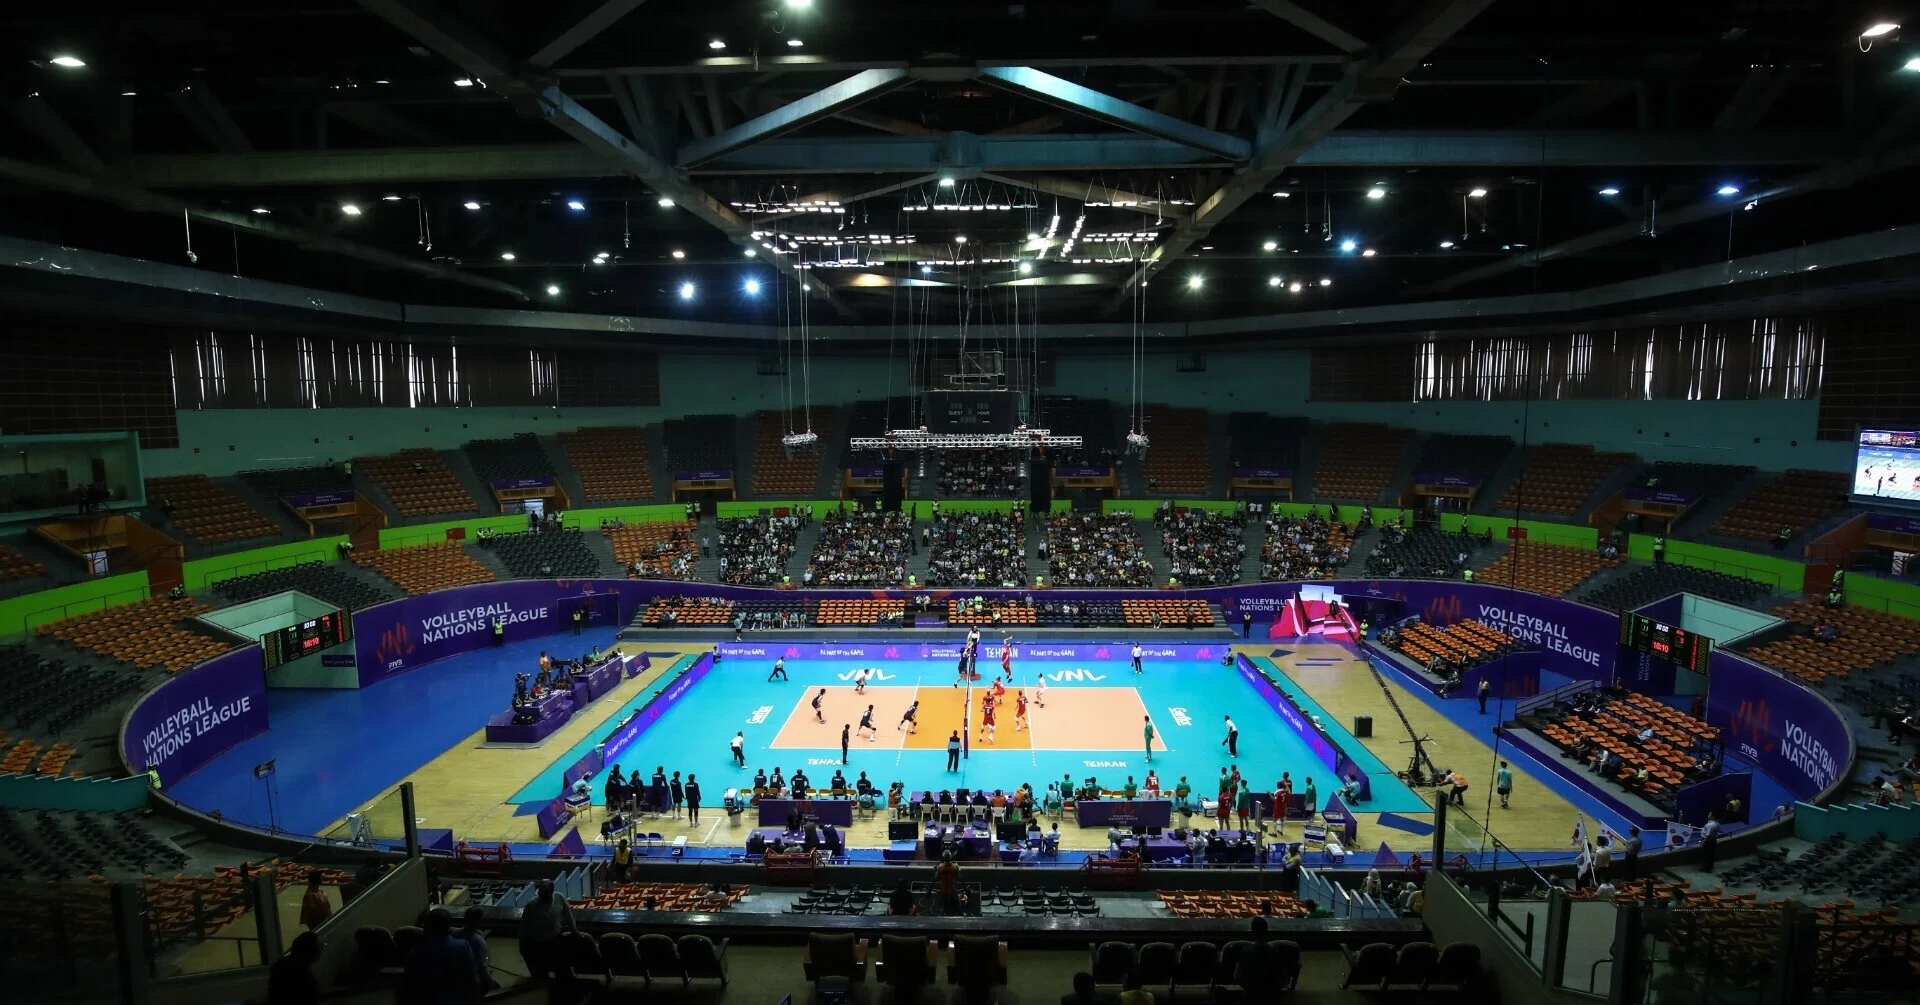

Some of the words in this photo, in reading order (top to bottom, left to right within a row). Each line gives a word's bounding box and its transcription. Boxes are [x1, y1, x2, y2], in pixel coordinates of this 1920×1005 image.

[422, 601, 512, 631] VOLLEYBALL
[422, 619, 487, 645] NATIONS
[492, 607, 549, 628] LEAGUE
[1479, 604, 1568, 640] VOLLEYBALL
[1547, 636, 1600, 667] LEAGUE
[1047, 668, 1107, 681] VNL
[142, 696, 214, 754] VOLLEYBALL
[195, 696, 251, 737] LEAGUE
[807, 758, 843, 766] TEHRA
[1083, 760, 1127, 768] TEHRAN
[1781, 738, 1825, 791] NATIONS
[1785, 719, 1838, 781] VOLLEYBALL
